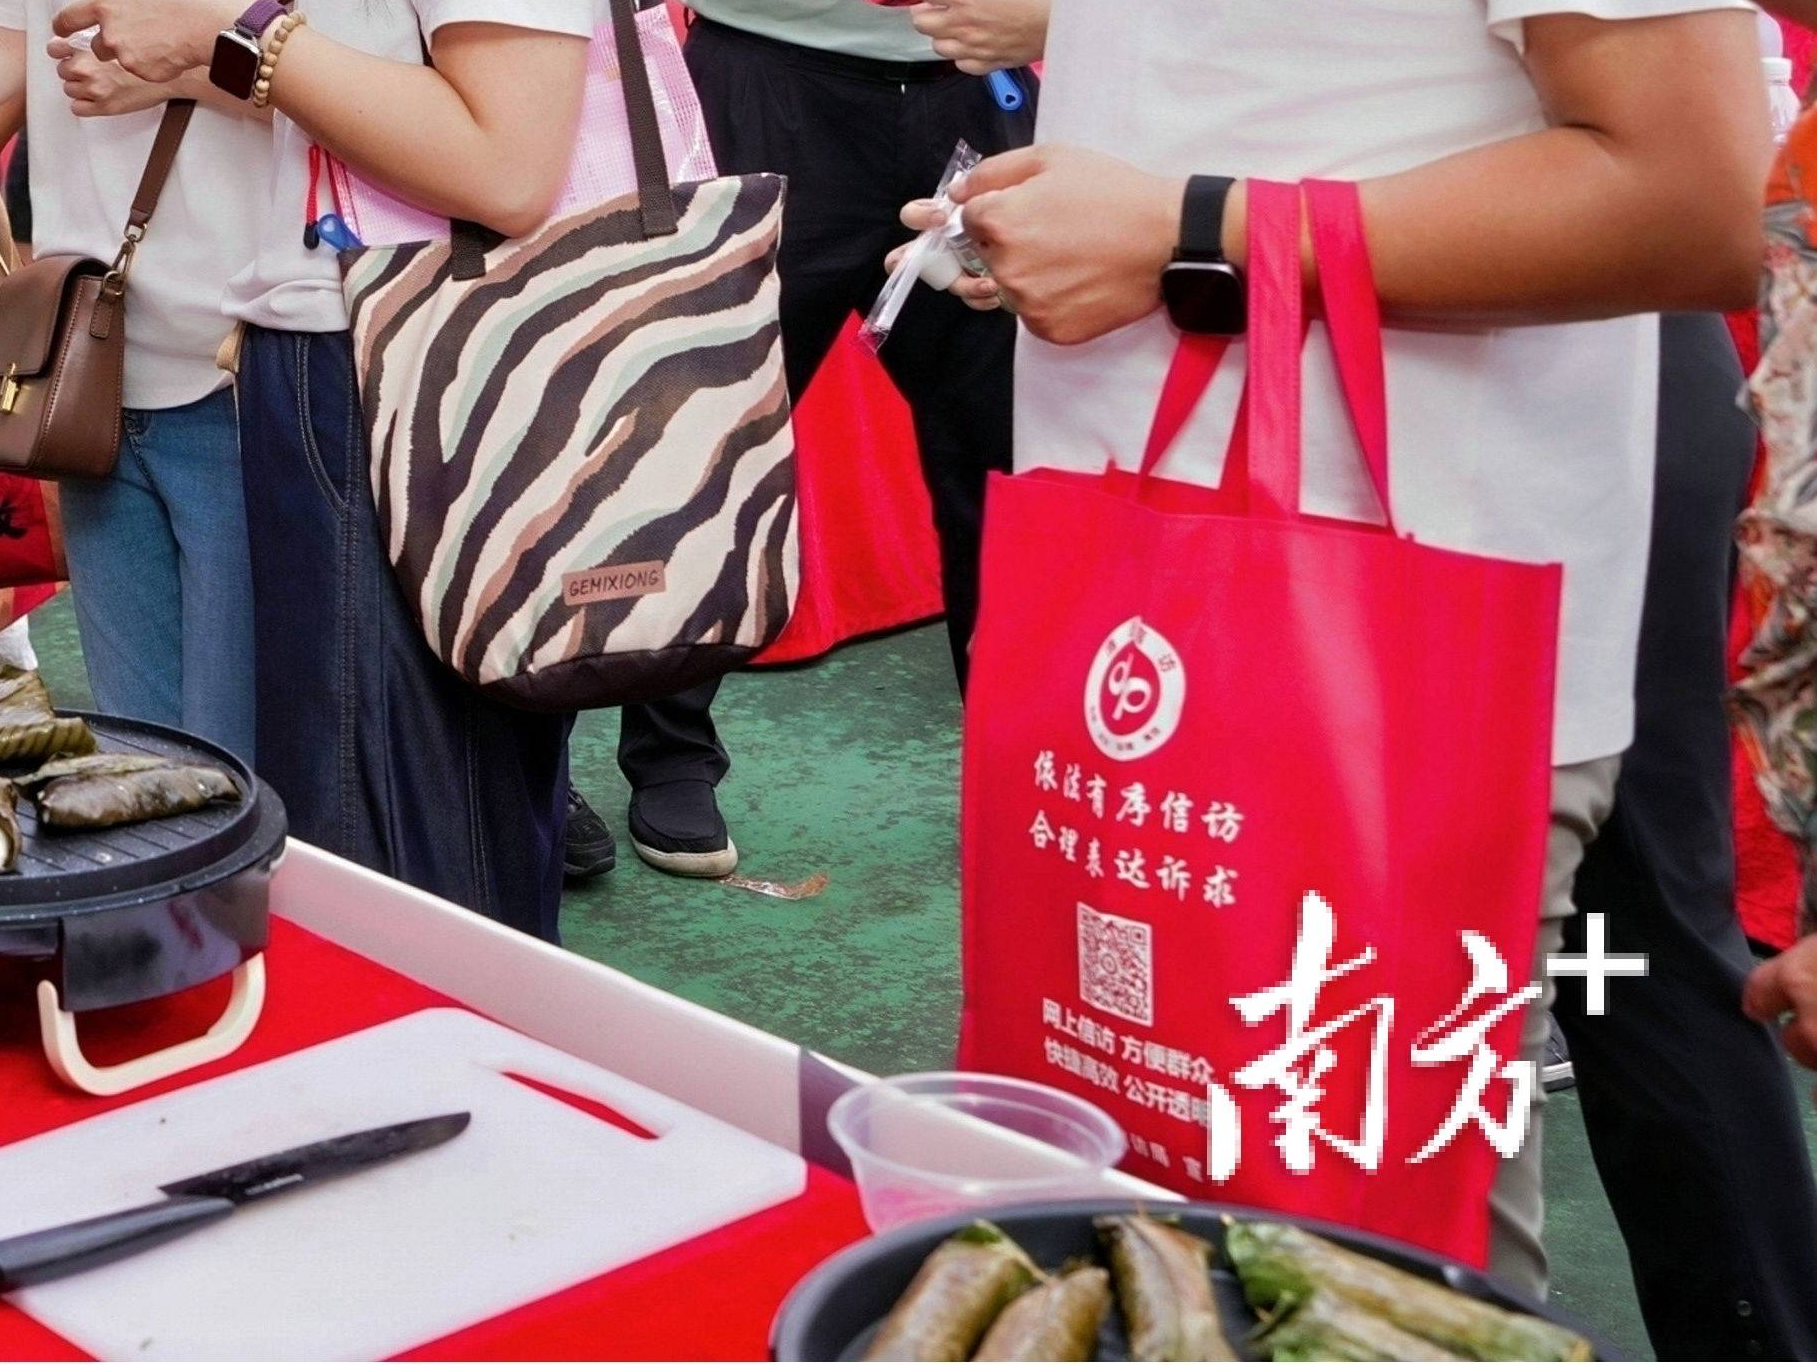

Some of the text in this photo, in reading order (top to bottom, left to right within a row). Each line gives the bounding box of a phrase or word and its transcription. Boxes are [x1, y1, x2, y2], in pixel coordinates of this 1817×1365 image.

[569, 569, 659, 597] GEMIXIONG
[1034, 750, 1245, 843] 依法有序信访
[1029, 809, 1239, 909] 合理表达诉求
[1119, 1034, 1216, 1086] 方便群众
